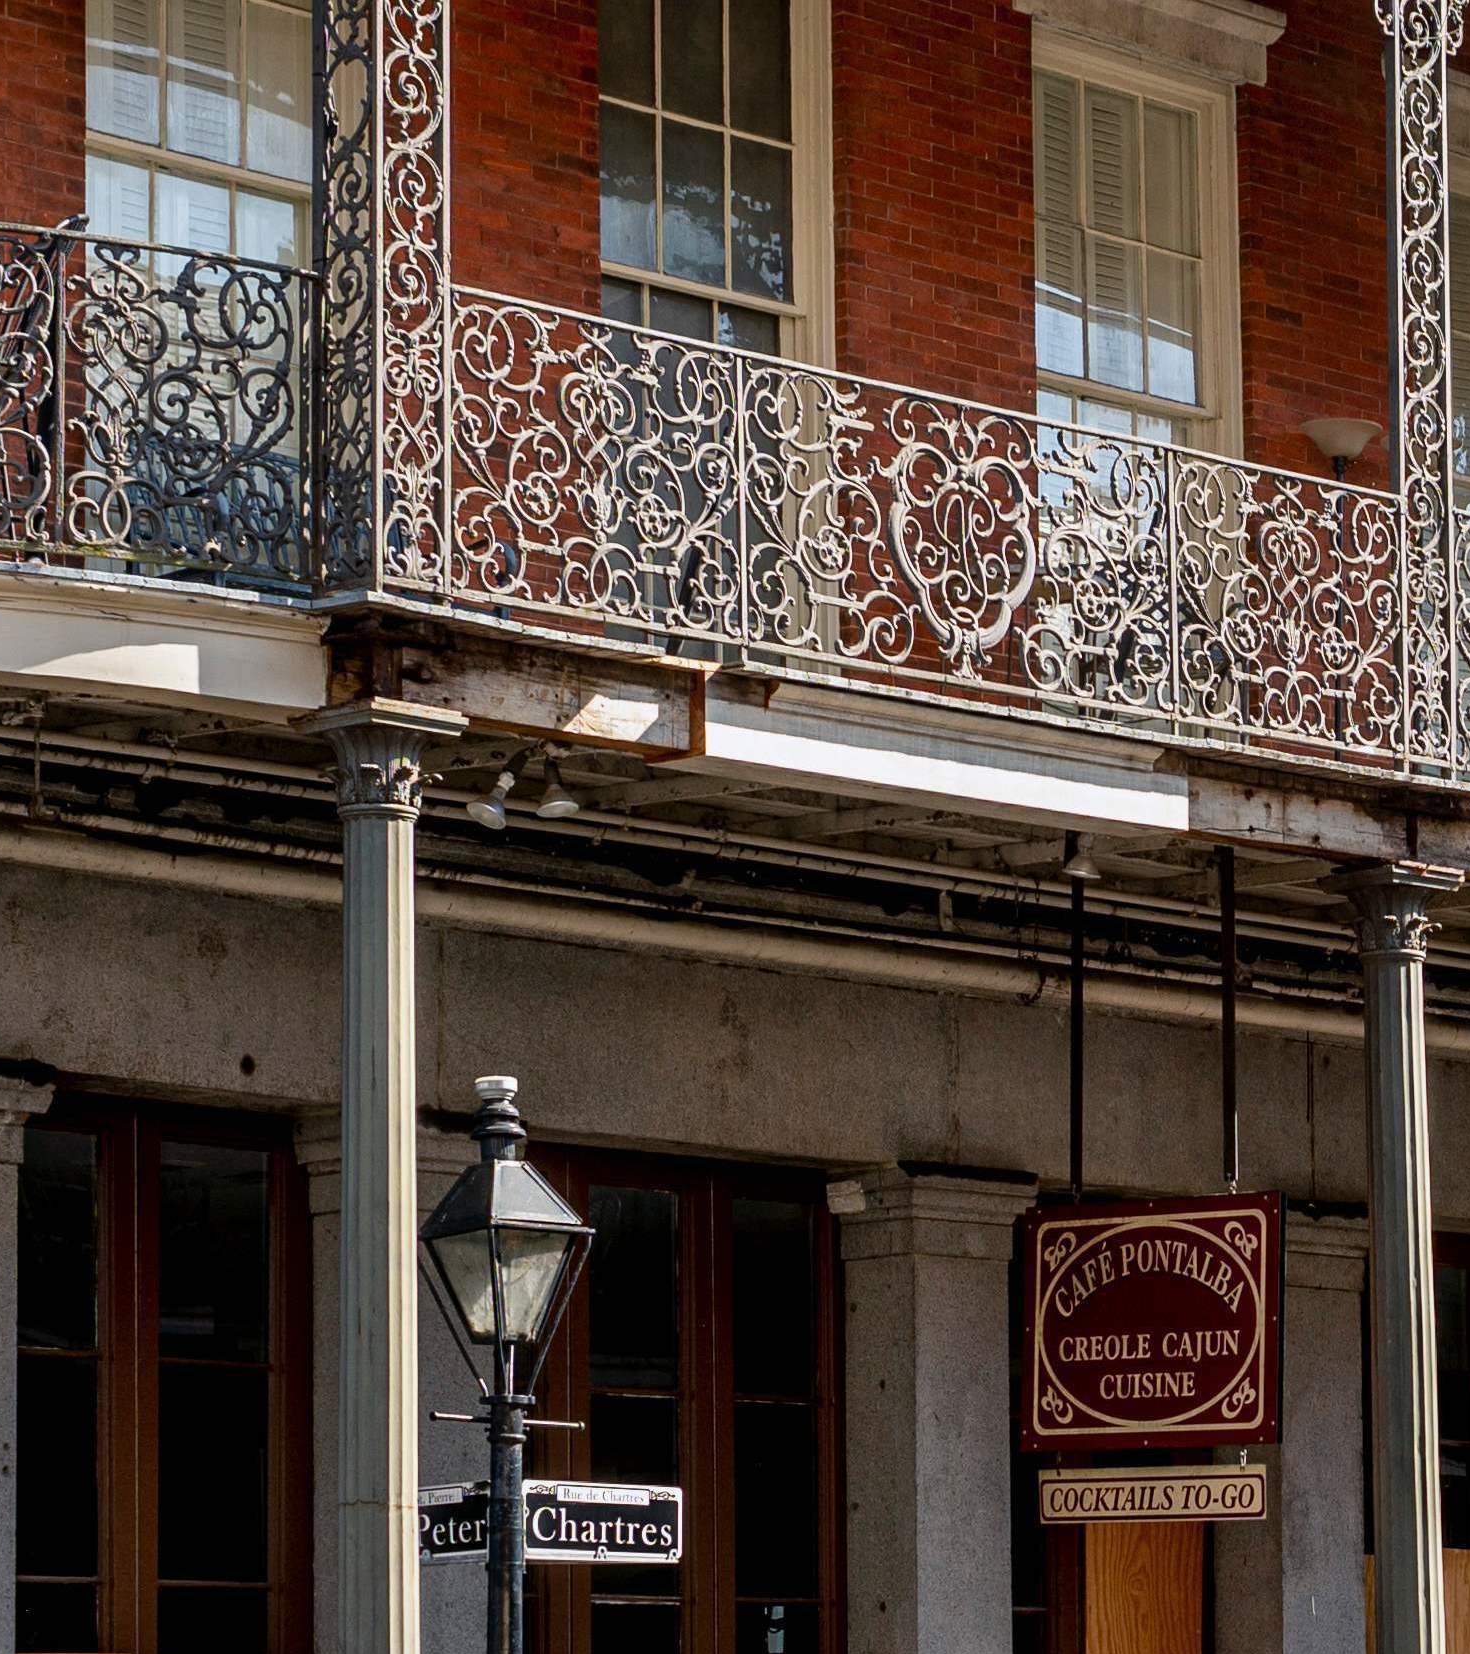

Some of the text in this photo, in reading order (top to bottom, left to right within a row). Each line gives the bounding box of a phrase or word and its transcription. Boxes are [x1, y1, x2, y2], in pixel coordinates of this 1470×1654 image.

[1055, 1239, 1246, 1317] CAFÉ PONTALBA
[1059, 1329, 1240, 1362] CREOLE CAJUN
[1099, 1371, 1196, 1400] CUISINE
[563, 1487, 645, 1503] Rue de Chartres
[1049, 1482, 1255, 1513] COCKTAILS TO-GO
[418, 1513, 486, 1547] Peter
[532, 1506, 673, 1546] Chartres
